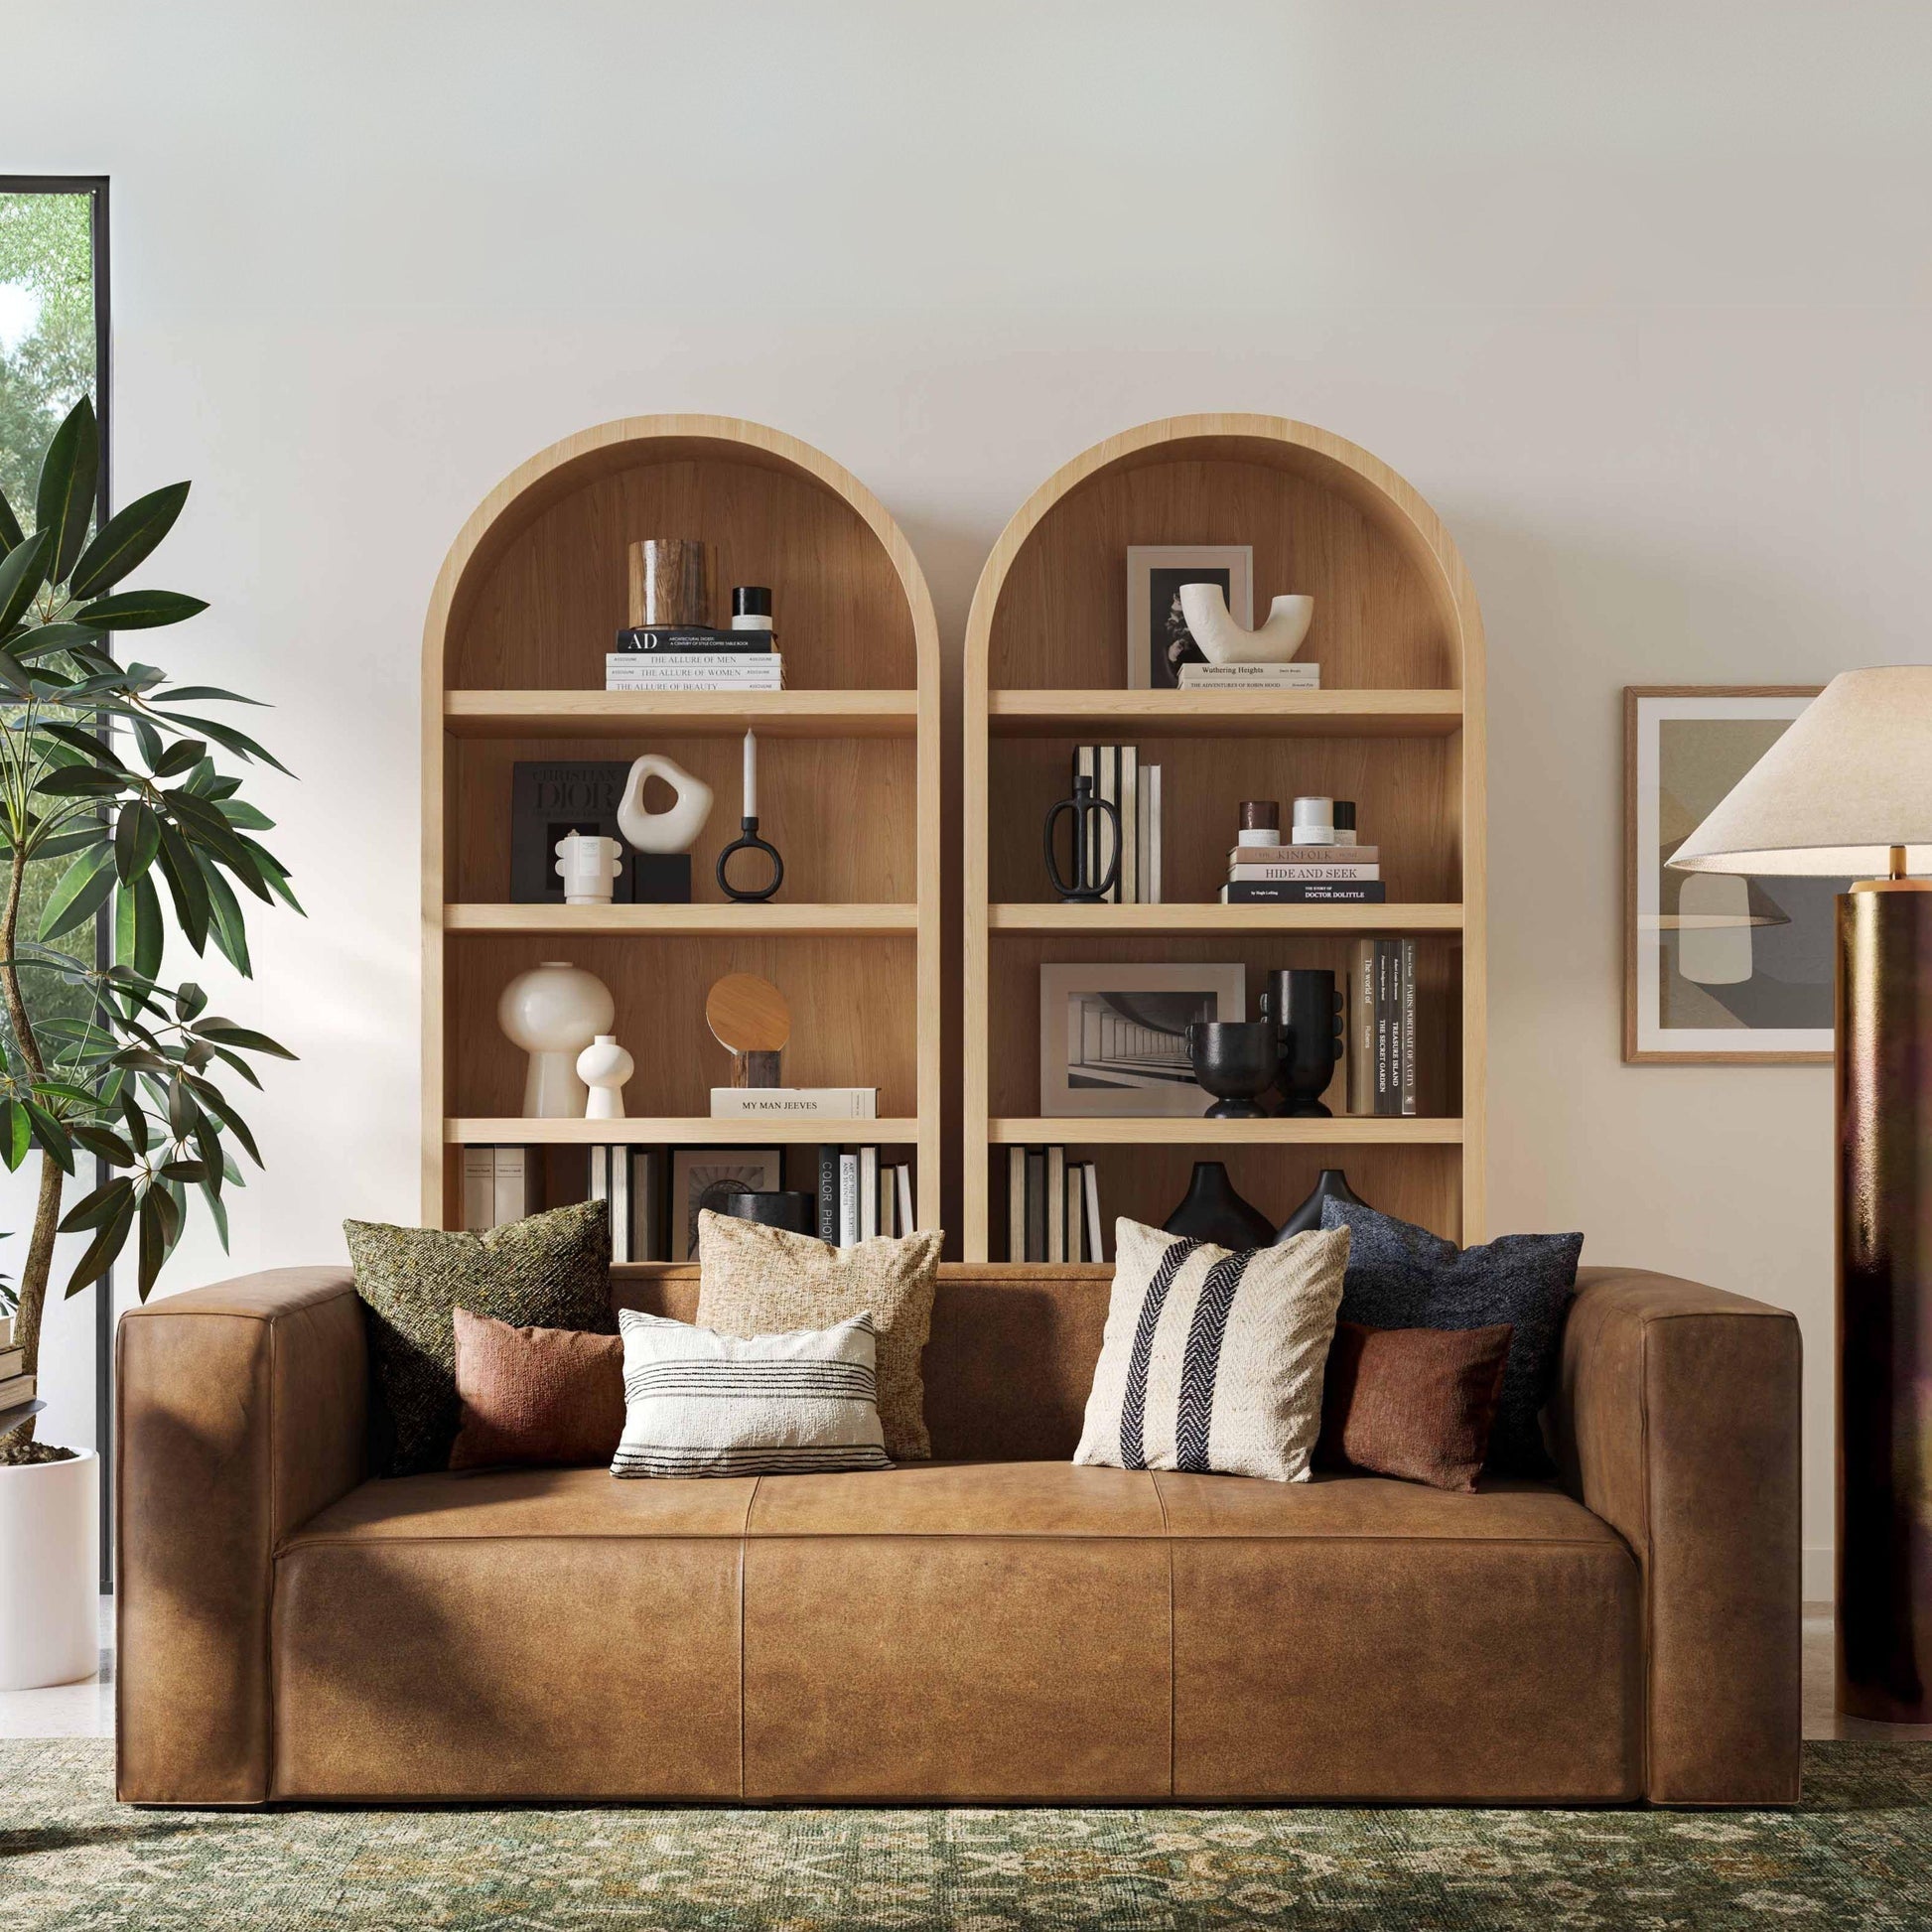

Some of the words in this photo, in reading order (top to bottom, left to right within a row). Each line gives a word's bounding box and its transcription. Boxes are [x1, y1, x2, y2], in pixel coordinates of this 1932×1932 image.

[627, 633, 658, 649] AD
[1202, 666, 1237, 675] Wuthering
[1238, 666, 1264, 675] Heights
[532, 769, 618, 781] CHRISTIAN
[536, 782, 615, 810] DIOR
[1277, 850, 1332, 860] KINFOLK
[1266, 869, 1295, 879] HIDE
[1298, 869, 1323, 879] AND
[1325, 869, 1357, 879] SEEK
[1365, 995, 1372, 1005] of
[1407, 1050, 1413, 1060] OF
[823, 1162, 832, 1201] COLOR
